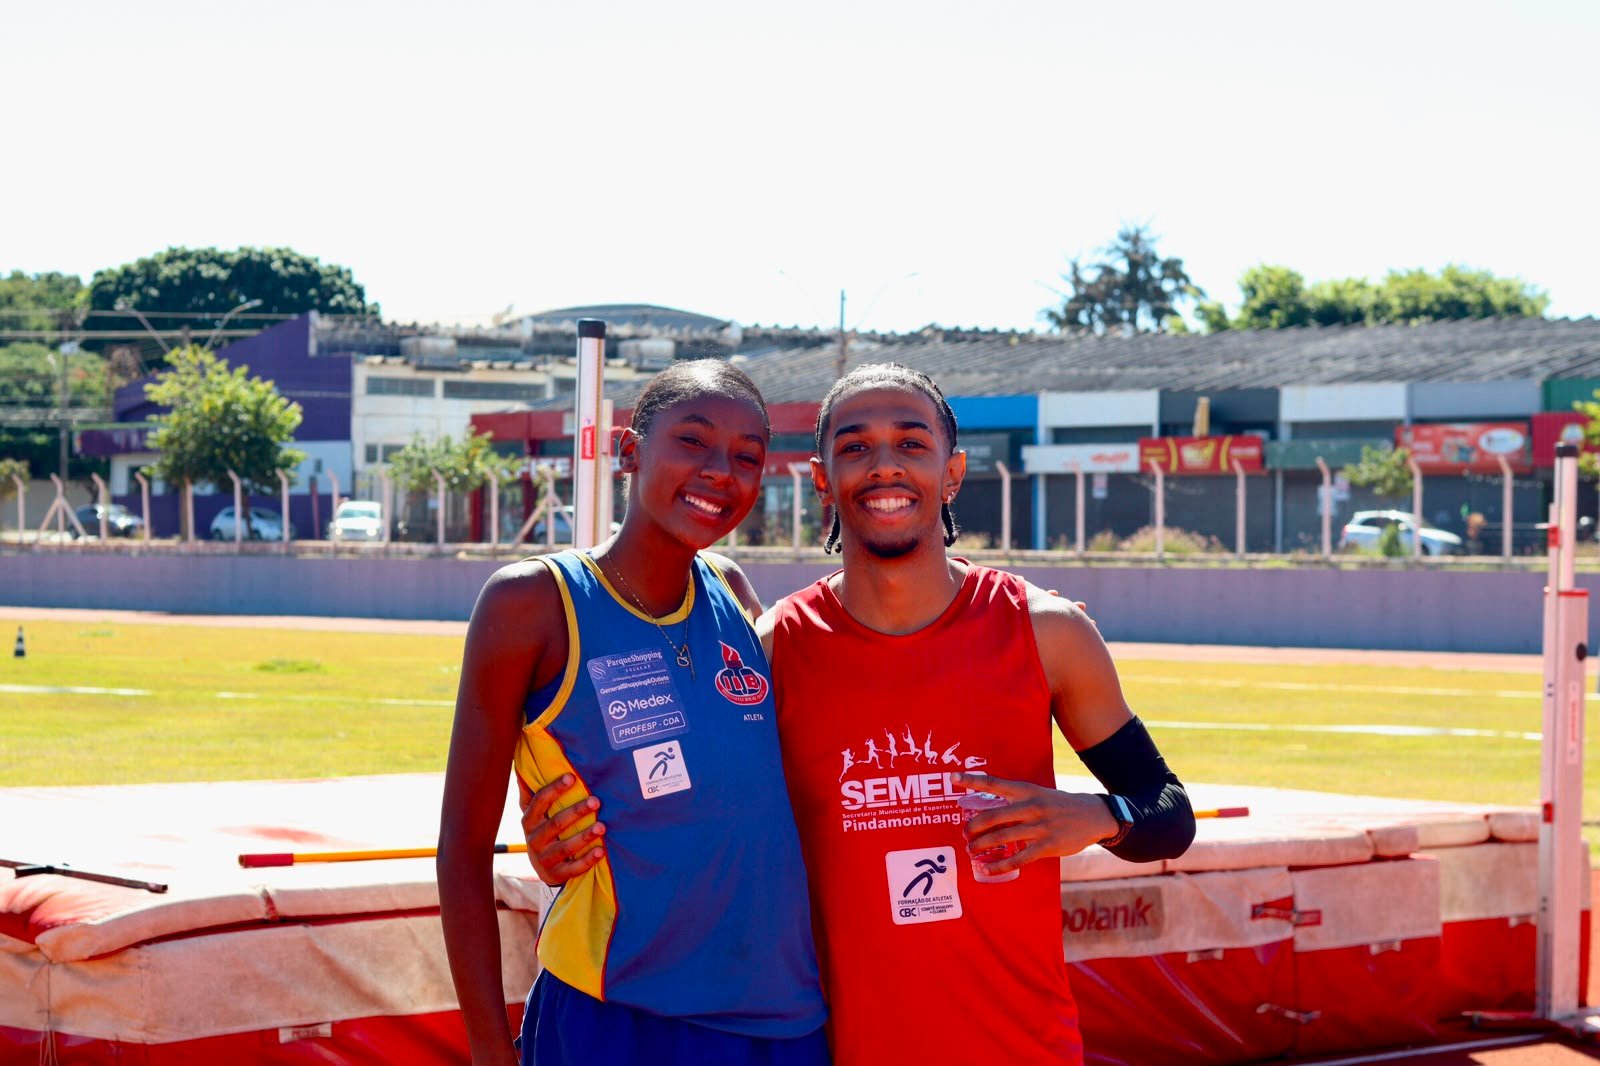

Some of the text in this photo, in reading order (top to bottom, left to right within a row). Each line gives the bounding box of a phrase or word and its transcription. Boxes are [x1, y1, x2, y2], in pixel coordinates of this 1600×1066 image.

[606, 651, 663, 667] ParqueShopping
[627, 694, 674, 711] Medex
[743, 713, 764, 721] ATLETA
[618, 721, 658, 737] PROFESP
[842, 810, 877, 819] Secretaria
[878, 806, 912, 815] Municipal
[923, 803, 954, 812] Esportes
[843, 812, 963, 832] Pindamonhang
[899, 907, 917, 918] CBC
